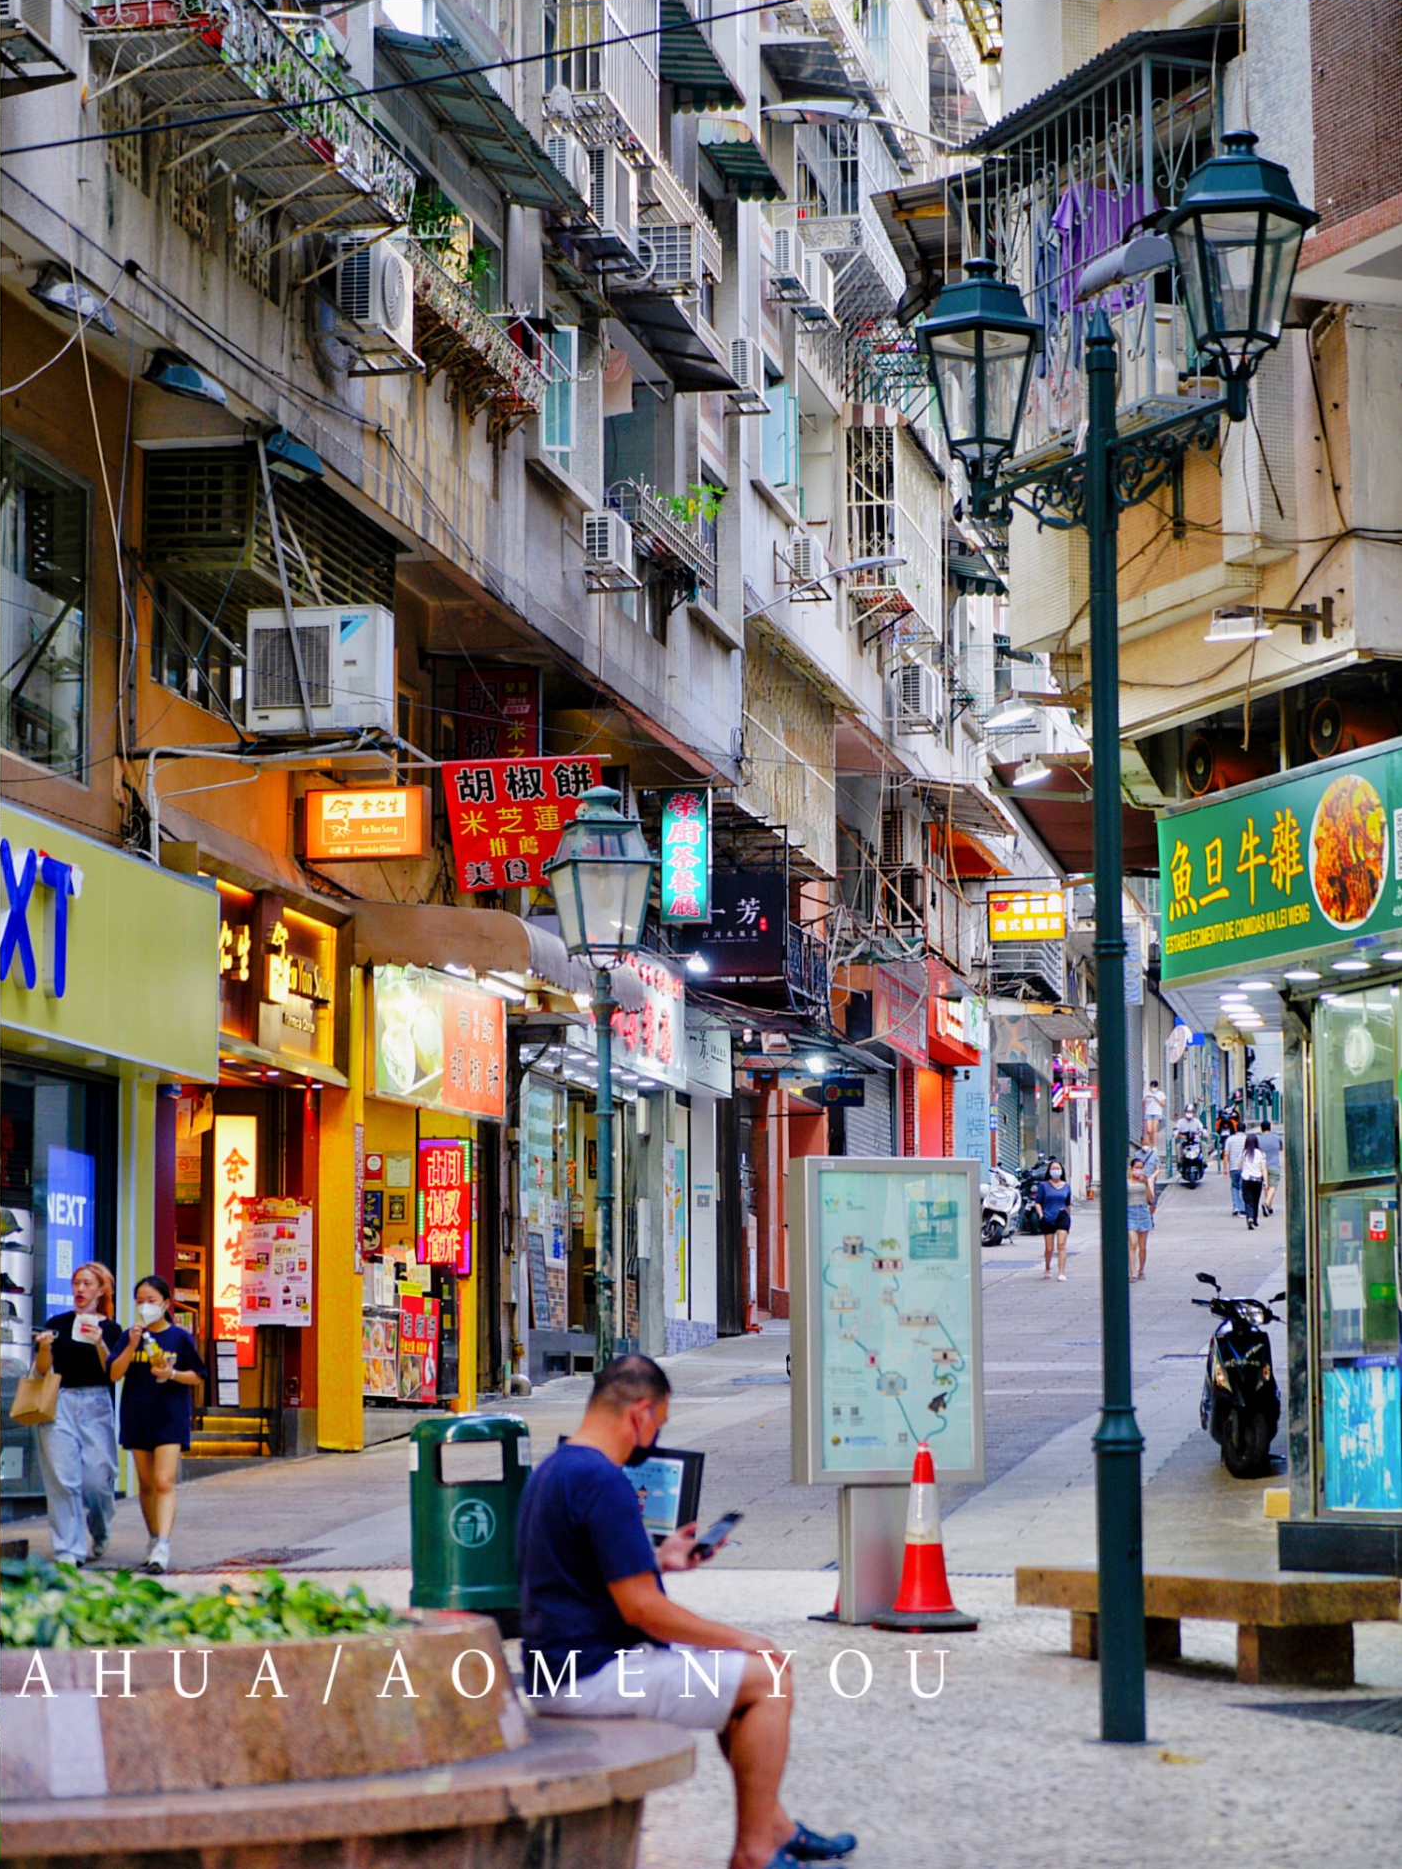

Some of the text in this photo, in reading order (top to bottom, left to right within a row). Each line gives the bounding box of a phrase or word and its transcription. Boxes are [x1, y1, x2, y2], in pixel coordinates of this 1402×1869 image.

[455, 761, 594, 804] 胡椒餅
[360, 798, 399, 813] 余仁生
[459, 804, 562, 837] 米芝蓮
[489, 835, 540, 857] 推薦
[1168, 806, 1305, 923] 魚旦牛雜
[463, 857, 555, 889] 美食
[1165, 903, 1310, 955] ESTABELECIMENTO DE COMIDAS KA LEI WENG
[47, 1191, 87, 1228] NEXT
[221, 1147, 250, 1266] 余仁生
[426, 1149, 462, 1263] 胡椒餅
